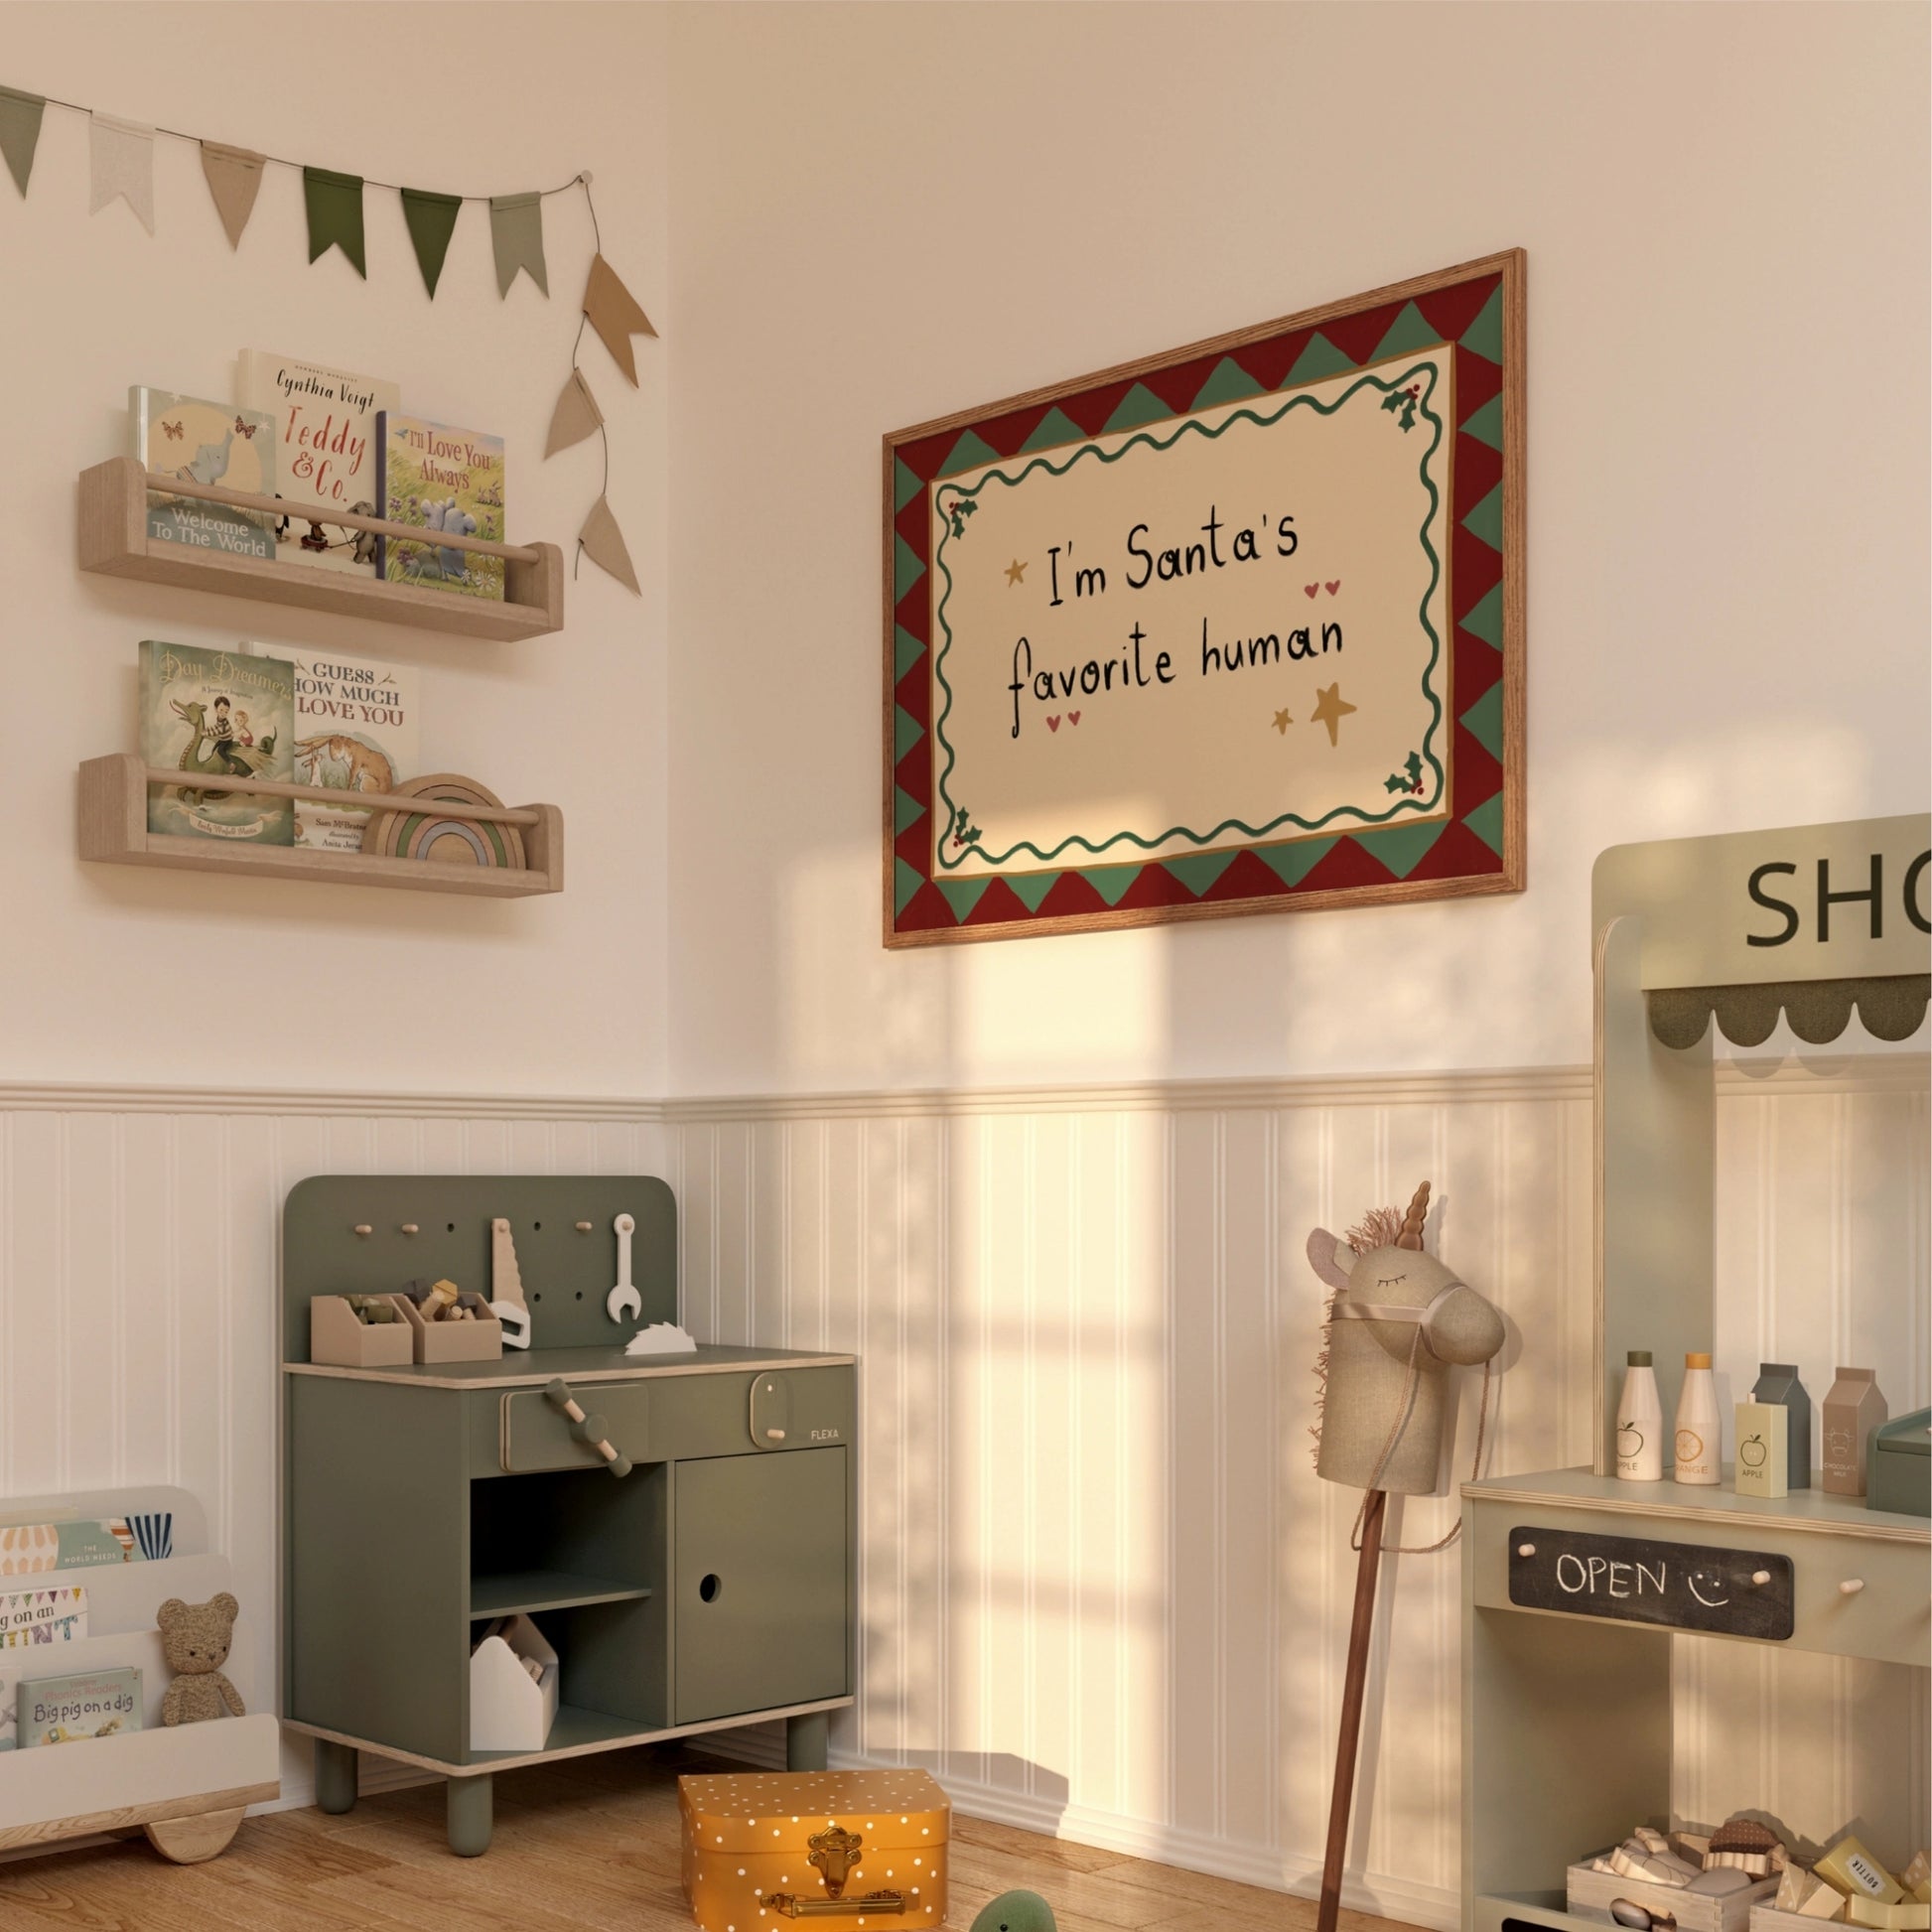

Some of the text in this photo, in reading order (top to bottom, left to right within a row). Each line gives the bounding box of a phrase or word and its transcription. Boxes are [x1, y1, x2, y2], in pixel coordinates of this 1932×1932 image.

[276, 368, 334, 398] Cynthia
[340, 383, 374, 415] Voigt
[285, 404, 366, 476] Teddy
[409, 430, 490, 471] I'll Love You
[292, 451, 347, 502] & Co.
[419, 458, 471, 494] Always
[172, 507, 249, 537] Welcome
[151, 520, 267, 558] To The World
[1047, 504, 1299, 607] I'm Santa's
[159, 649, 293, 701] Day Dreamers
[313, 662, 375, 685] GUESS
[1008, 617, 1343, 739] favorite human
[340, 684, 400, 707] MUCH
[297, 696, 405, 728] LOVE YOU
[810, 1429, 840, 1441] FLEXA
[1617, 1460, 1638, 1471] PPLE
[1741, 1468, 1764, 1479] APPLE
[65, 1552, 117, 1564] WORLD NEEDS
[1557, 1554, 1666, 1598] OPEN
[14, 1610, 33, 1624] on
[37, 1606, 55, 1618] an
[34, 1694, 134, 1724] Big pig on a dig
[1852, 1860, 1879, 1888] BUTTER
